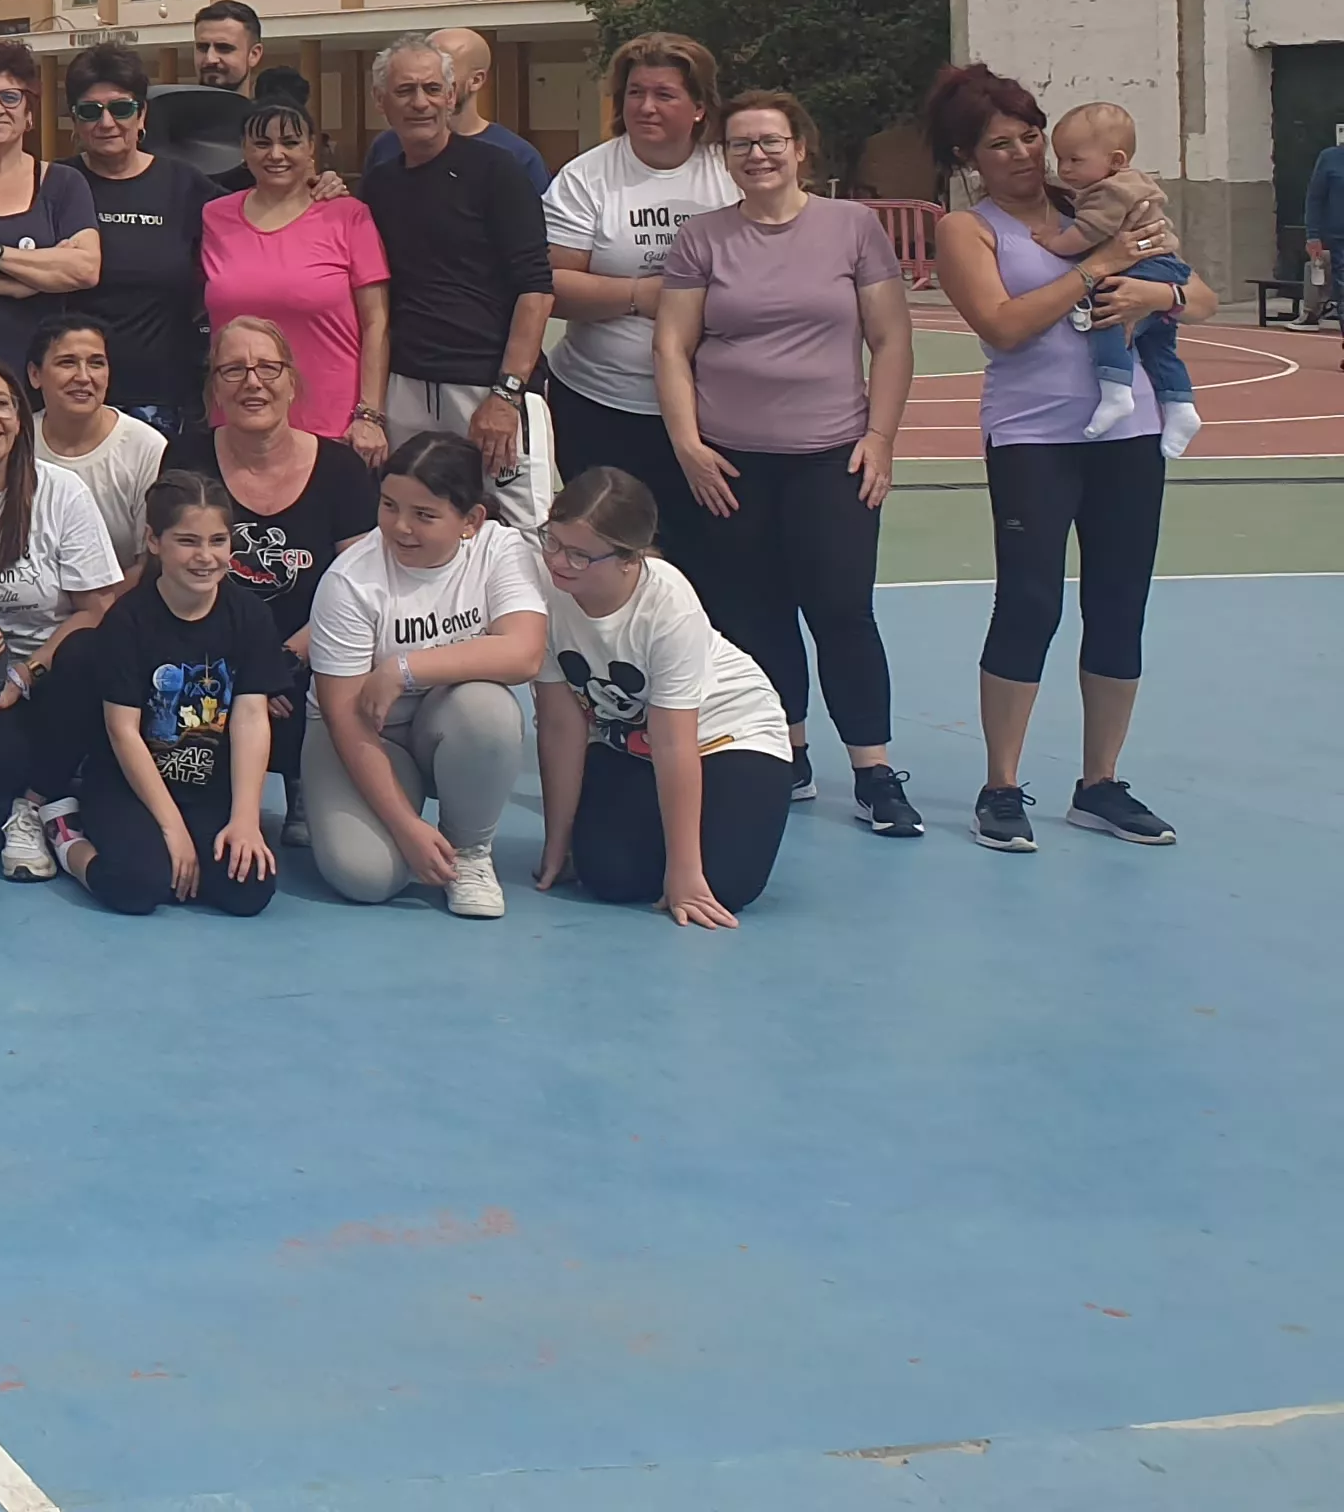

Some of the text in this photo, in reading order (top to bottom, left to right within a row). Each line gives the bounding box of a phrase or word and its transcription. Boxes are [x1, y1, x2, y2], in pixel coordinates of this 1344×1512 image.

[98, 213, 163, 225] ABOUT YOU
[629, 207, 670, 227] una
[635, 233, 651, 245] un
[395, 607, 481, 644] una entre
[159, 760, 213, 785] ATS
